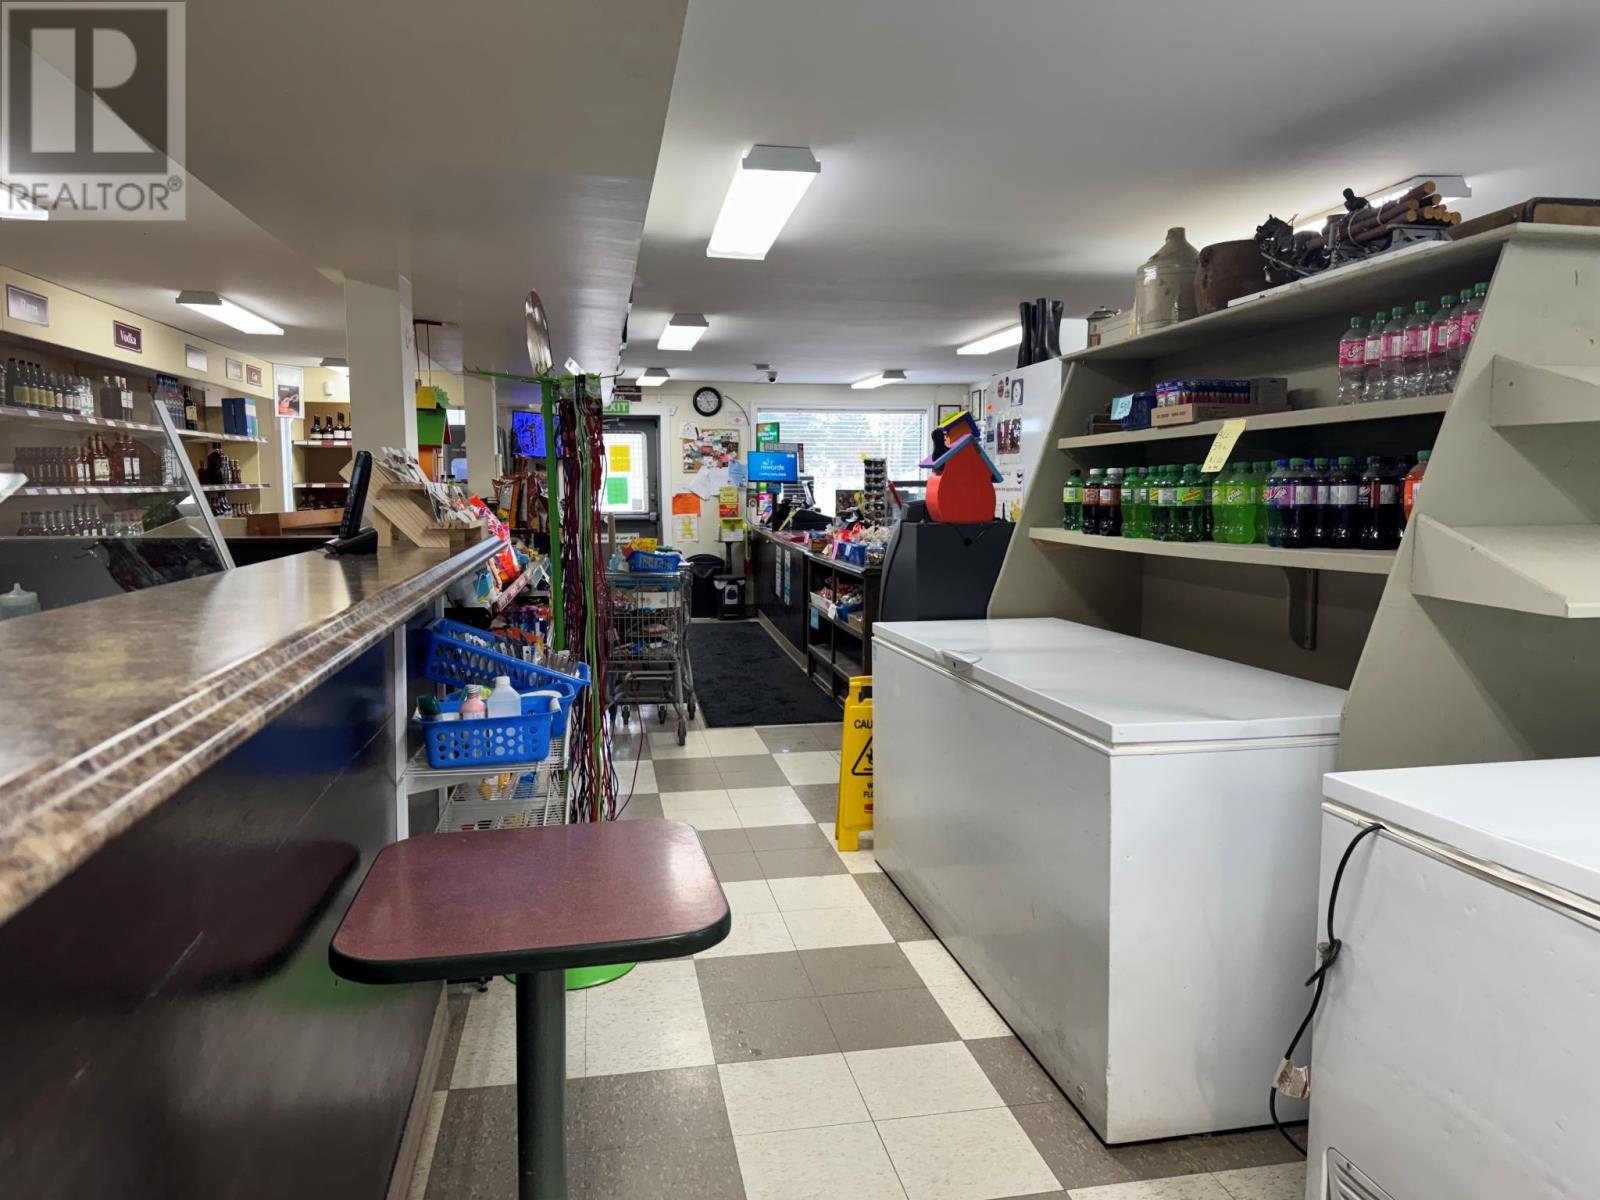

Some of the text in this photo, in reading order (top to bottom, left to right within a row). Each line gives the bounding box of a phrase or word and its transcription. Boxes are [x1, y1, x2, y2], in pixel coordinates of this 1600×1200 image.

[119, 329, 137, 345] Vodka
[1227, 488, 1242, 503] Crush
[854, 719, 873, 729] CAU
